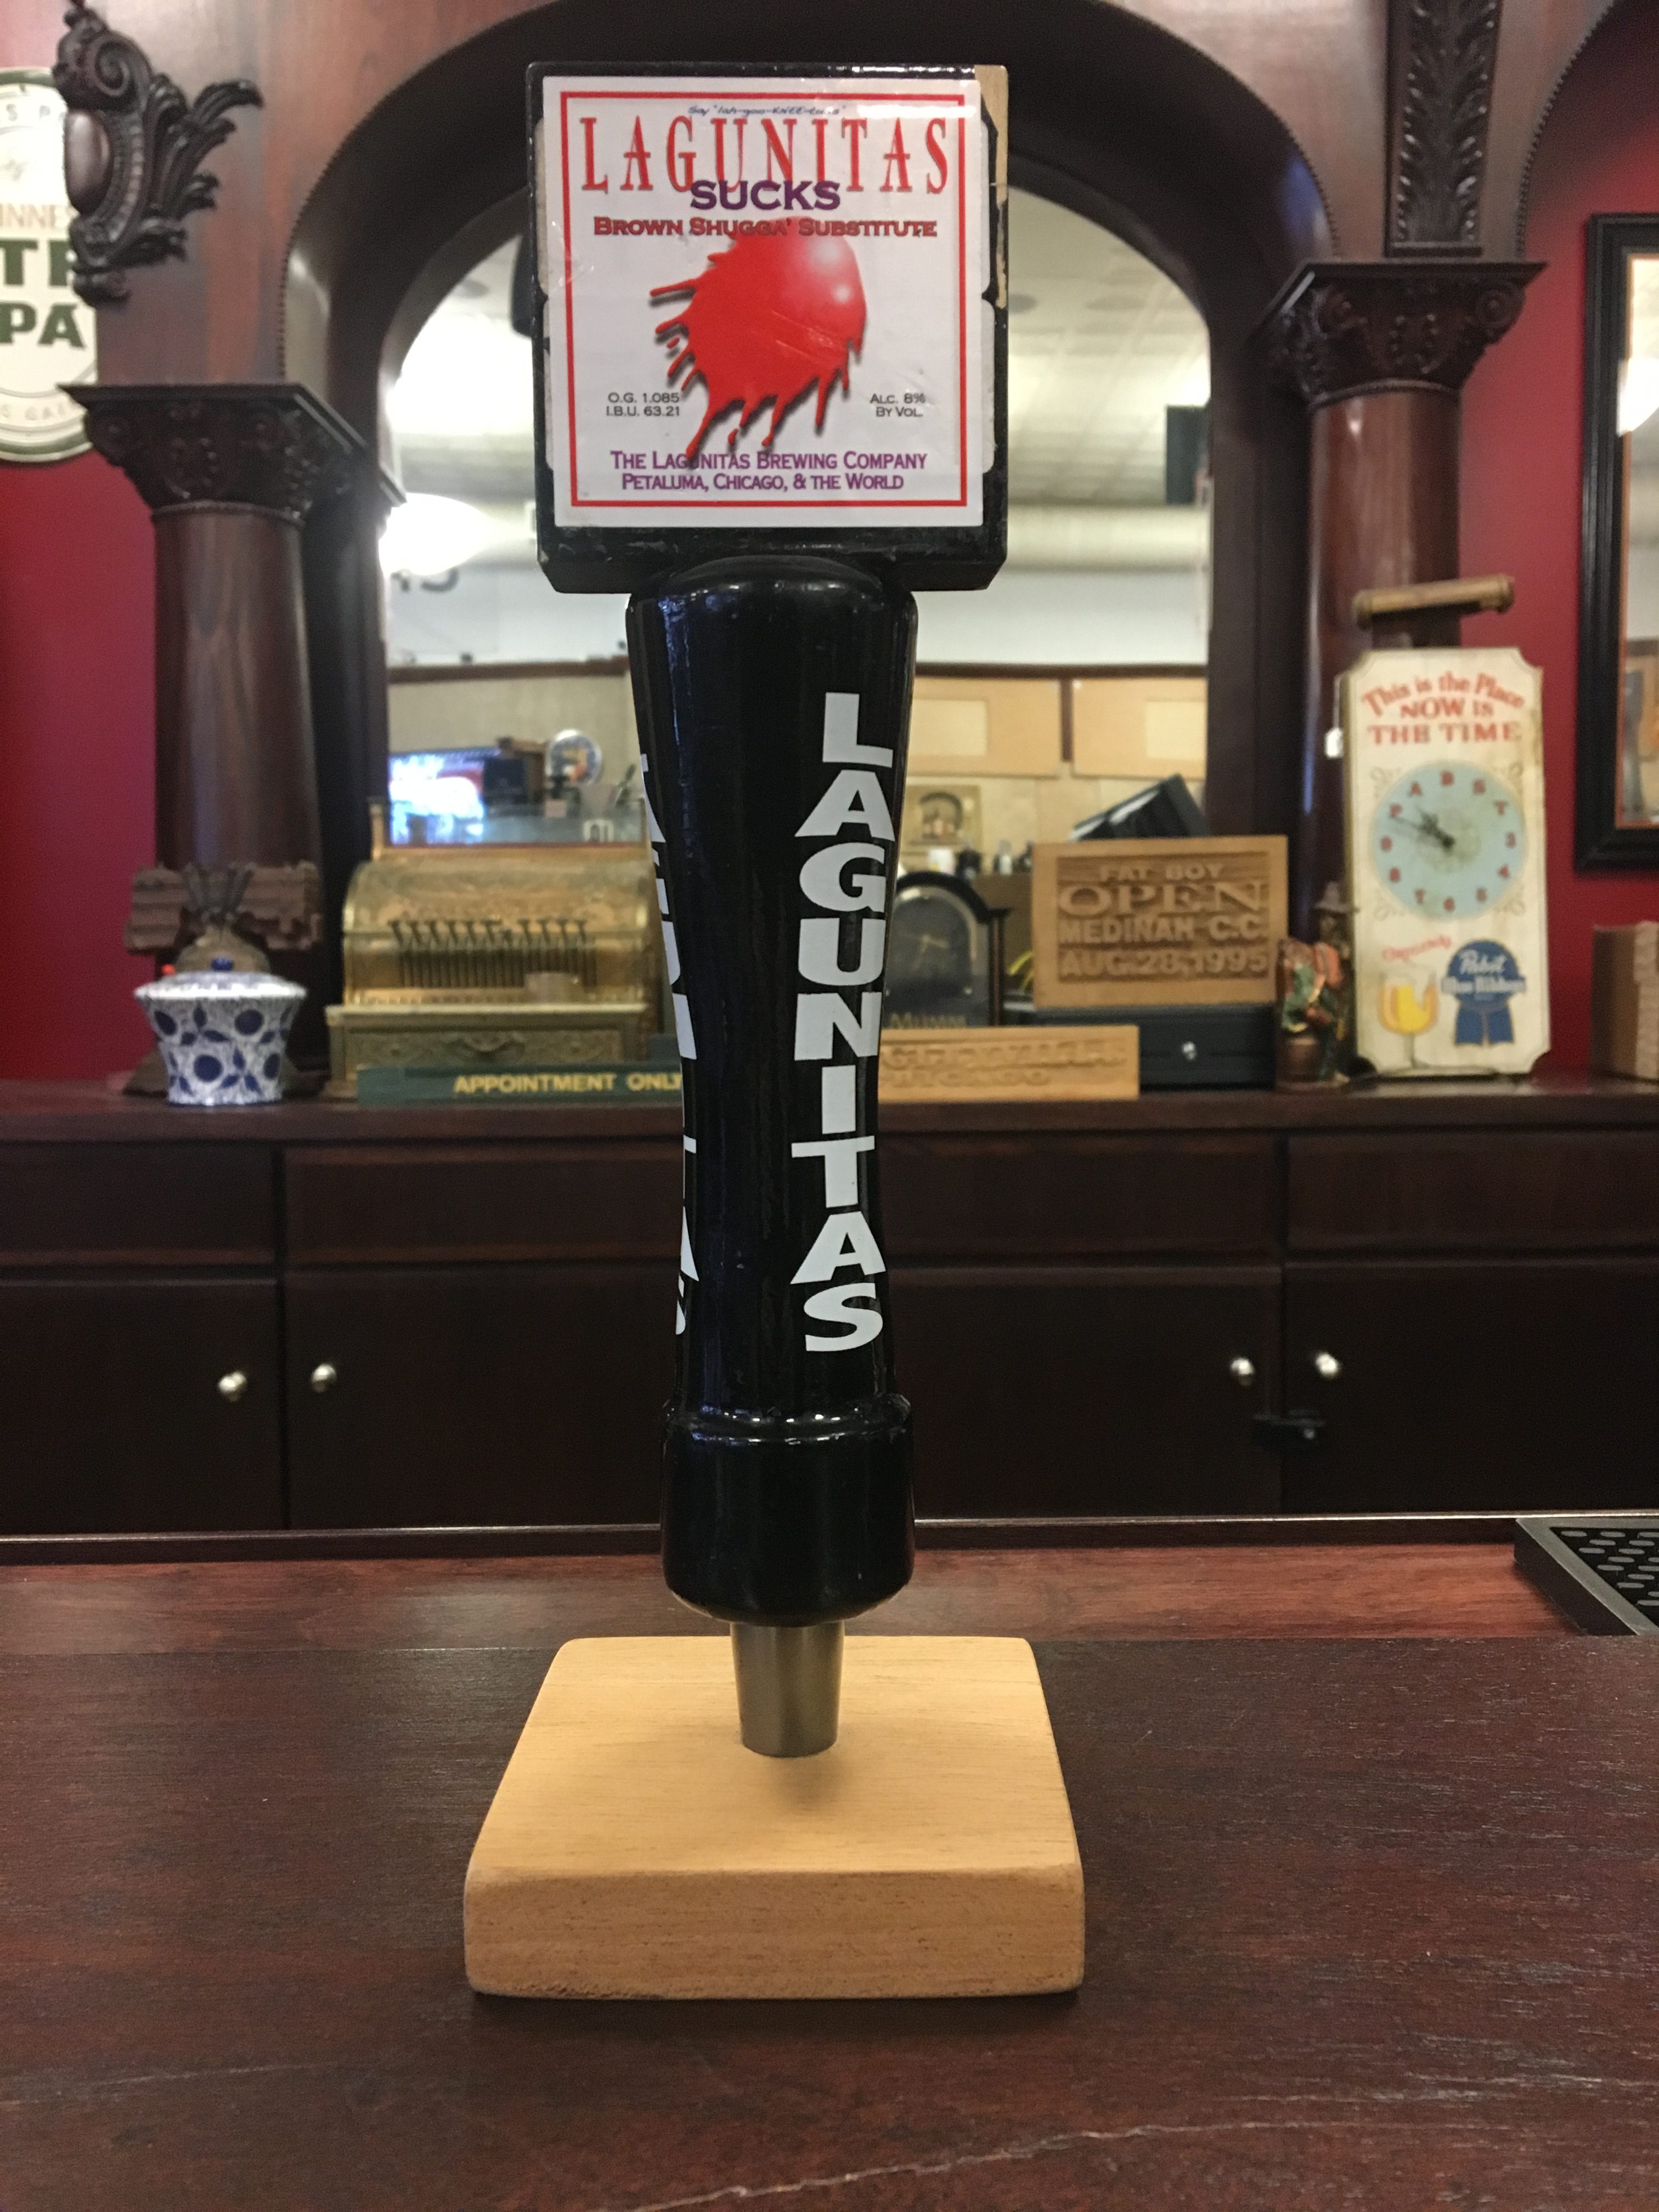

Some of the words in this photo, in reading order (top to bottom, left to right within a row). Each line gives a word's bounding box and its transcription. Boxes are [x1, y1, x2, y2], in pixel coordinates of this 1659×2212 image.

[580, 115, 948, 194] LAGUNITAS
[690, 180, 840, 211] SUCKS
[594, 216, 684, 236] BROWN
[798, 218, 938, 237] SUBSTITUTE
[608, 392, 637, 403] O.G.
[643, 392, 680, 403] 1.085
[870, 393, 899, 404] ALC.
[904, 393, 926, 404] 8%
[606, 406, 640, 416] I.B.U.
[644, 406, 680, 416] 63.21
[876, 407, 893, 417] BY
[610, 450, 646, 469] THE
[757, 451, 838, 470] BREWING
[843, 450, 927, 470] COMPANY
[622, 473, 709, 492] PETALUMA,
[713, 473, 788, 492] CHICAGO,
[793, 473, 806, 489] &
[810, 475, 841, 489] THE
[845, 473, 904, 489] WORLD
[1362, 684, 1409, 716] This
[1438, 670, 1470, 691] the
[1475, 672, 1525, 709] Place
[1401, 696, 1465, 718] NOW
[1472, 699, 1493, 717] IS
[1368, 724, 1430, 744] THE
[1438, 720, 1522, 743] TIME
[1166, 862, 1224, 881] BOY
[1059, 881, 1262, 917] OPEN
[791, 692, 896, 1352] LAGUNITAS
[454, 1073, 617, 1093] APPOINTMENT
